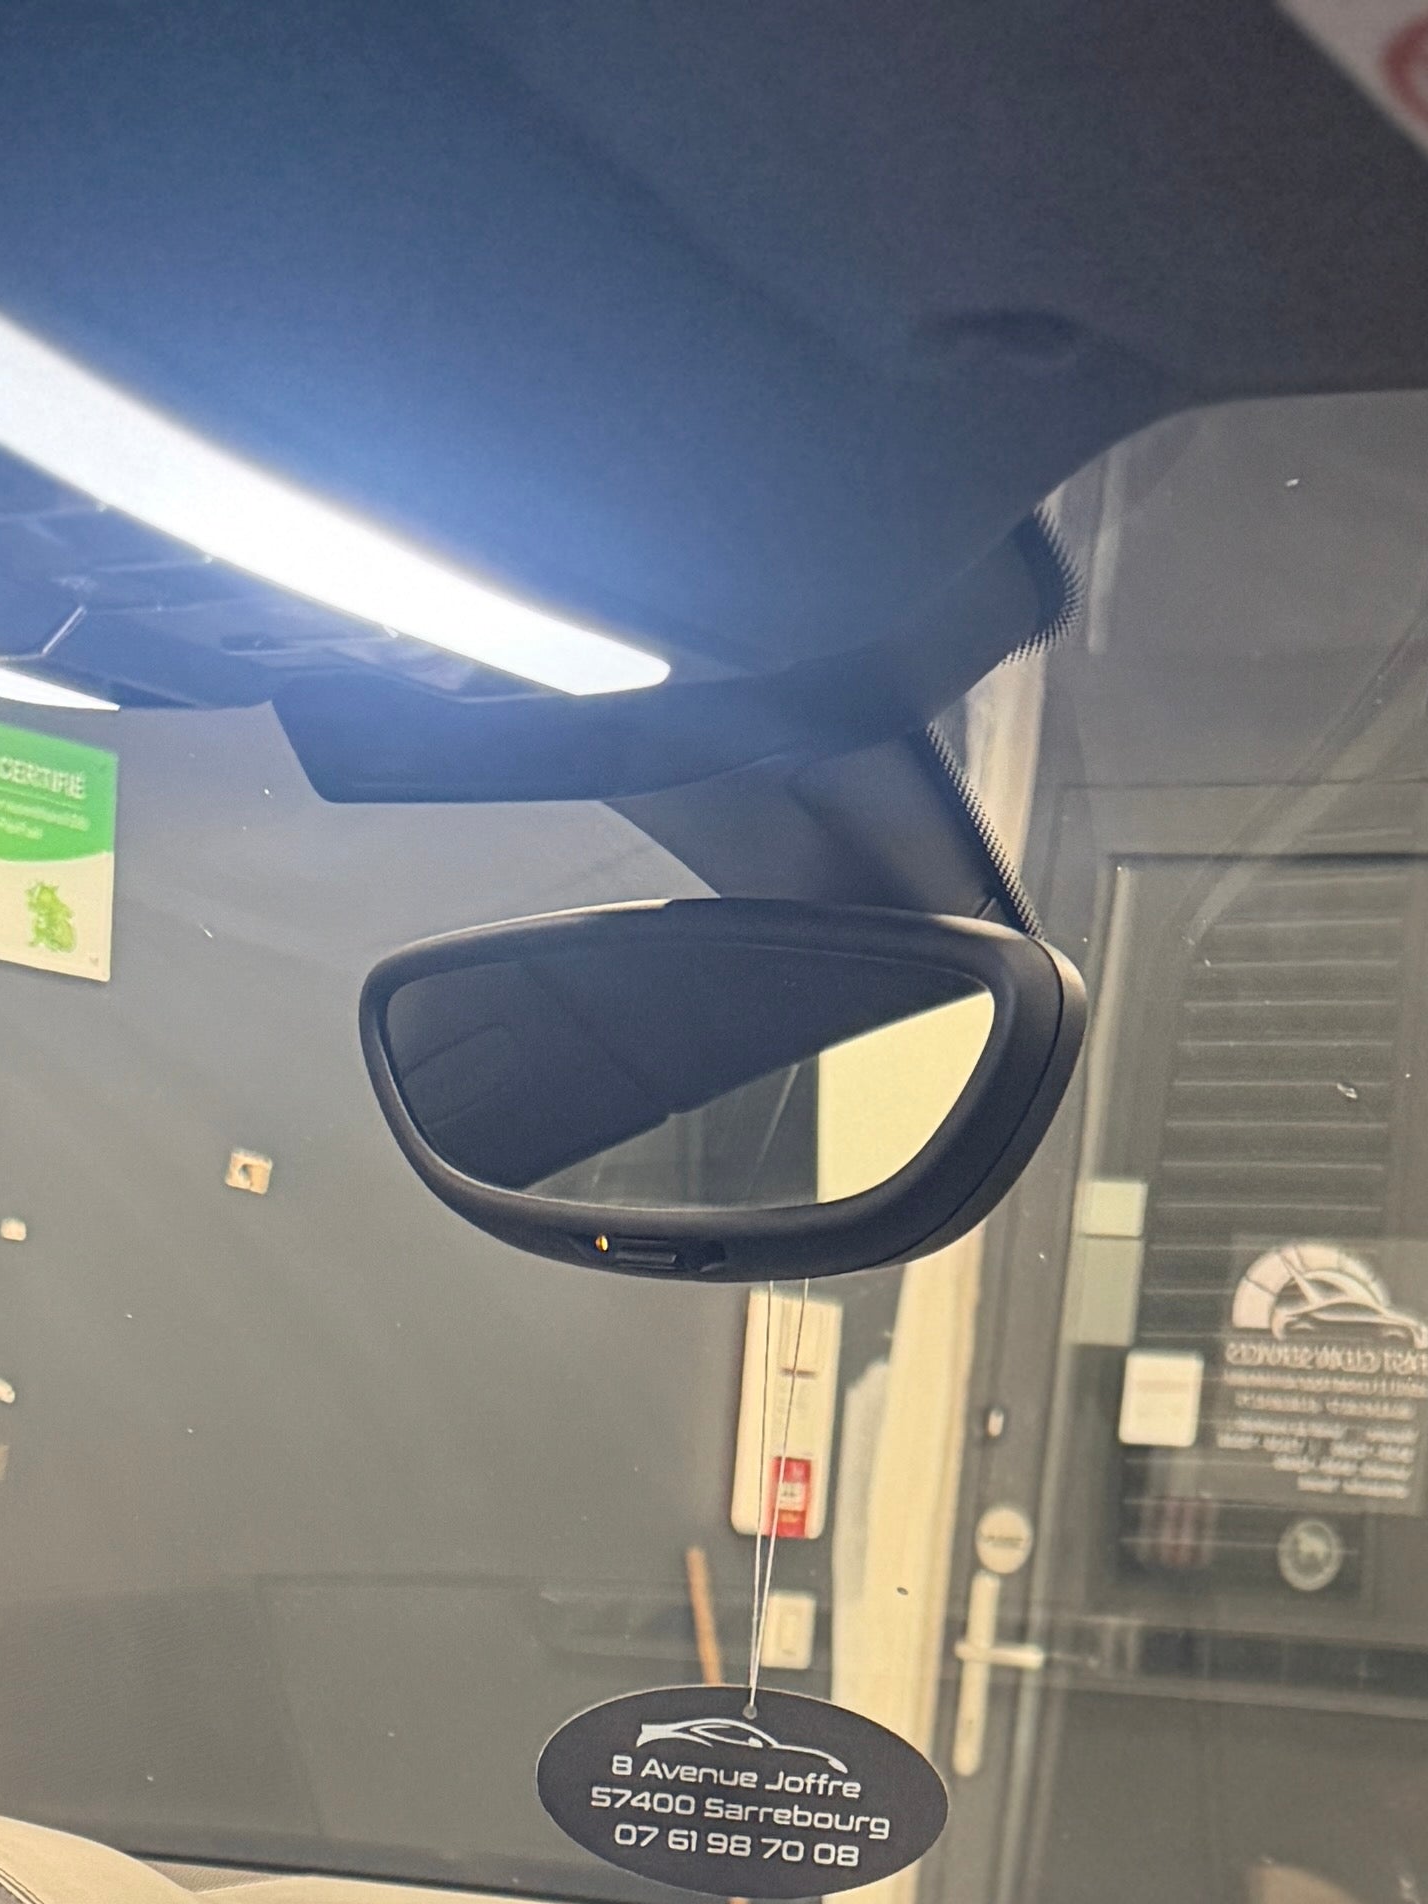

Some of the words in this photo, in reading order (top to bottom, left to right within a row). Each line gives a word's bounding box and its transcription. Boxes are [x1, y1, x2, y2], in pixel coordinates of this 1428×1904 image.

[611, 1754, 633, 1776] 8
[639, 1758, 759, 1789] Avenue
[764, 1770, 862, 1799] Joffre
[590, 1786, 696, 1816] 57400
[703, 1797, 891, 1841] Sarrebourg
[614, 1823, 659, 1847] 07
[668, 1828, 698, 1852] 61
[706, 1832, 752, 1857] 98
[760, 1838, 805, 1862] 70
[812, 1842, 860, 1867] 08
